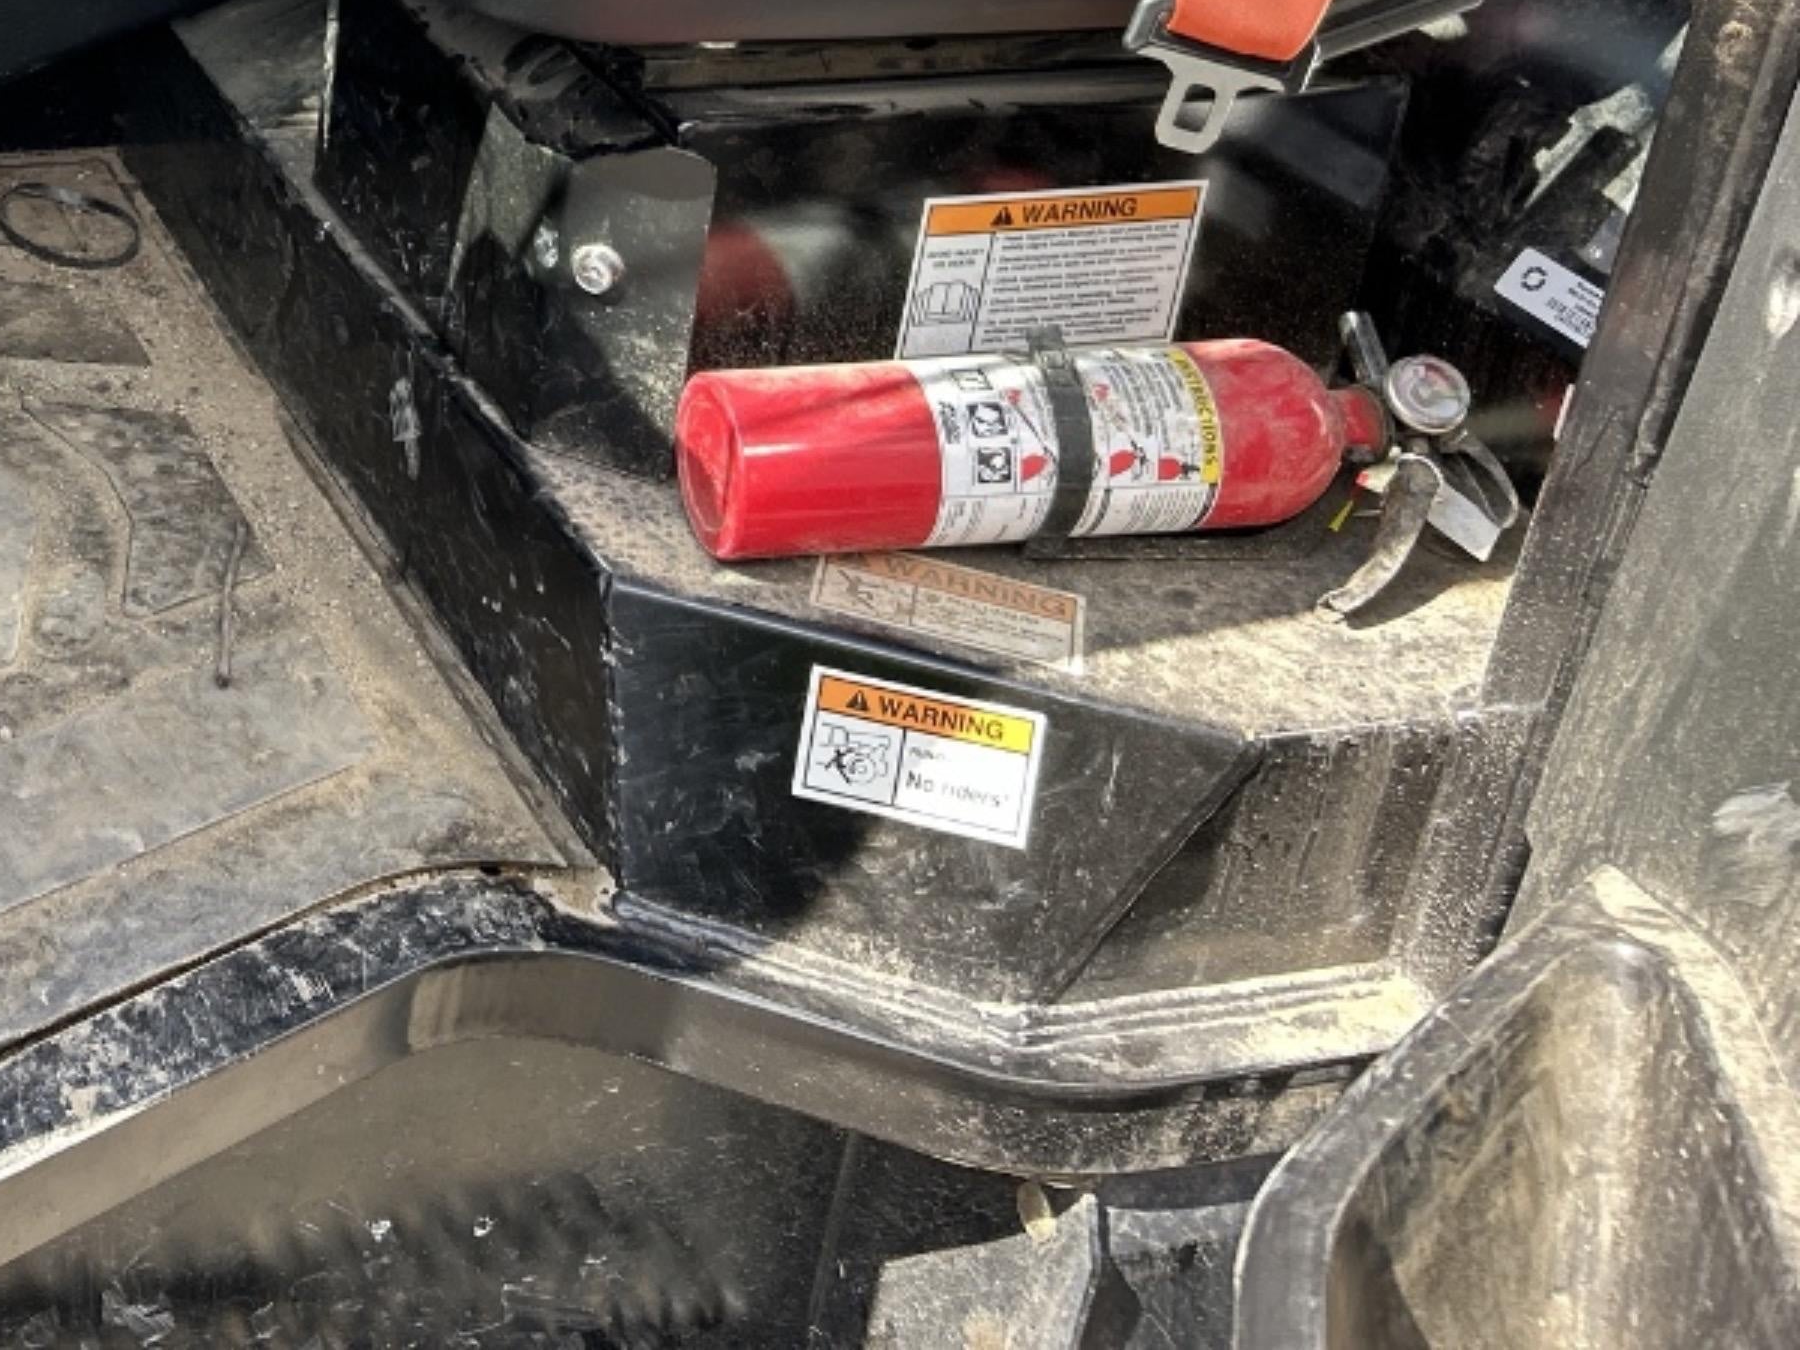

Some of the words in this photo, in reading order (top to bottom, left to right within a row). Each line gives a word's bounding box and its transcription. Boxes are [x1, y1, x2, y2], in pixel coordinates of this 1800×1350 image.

[1021, 197, 1138, 223] WARNING
[885, 554, 1067, 616] WARNING
[879, 695, 1004, 741] WARNING
[905, 770, 934, 792] No
